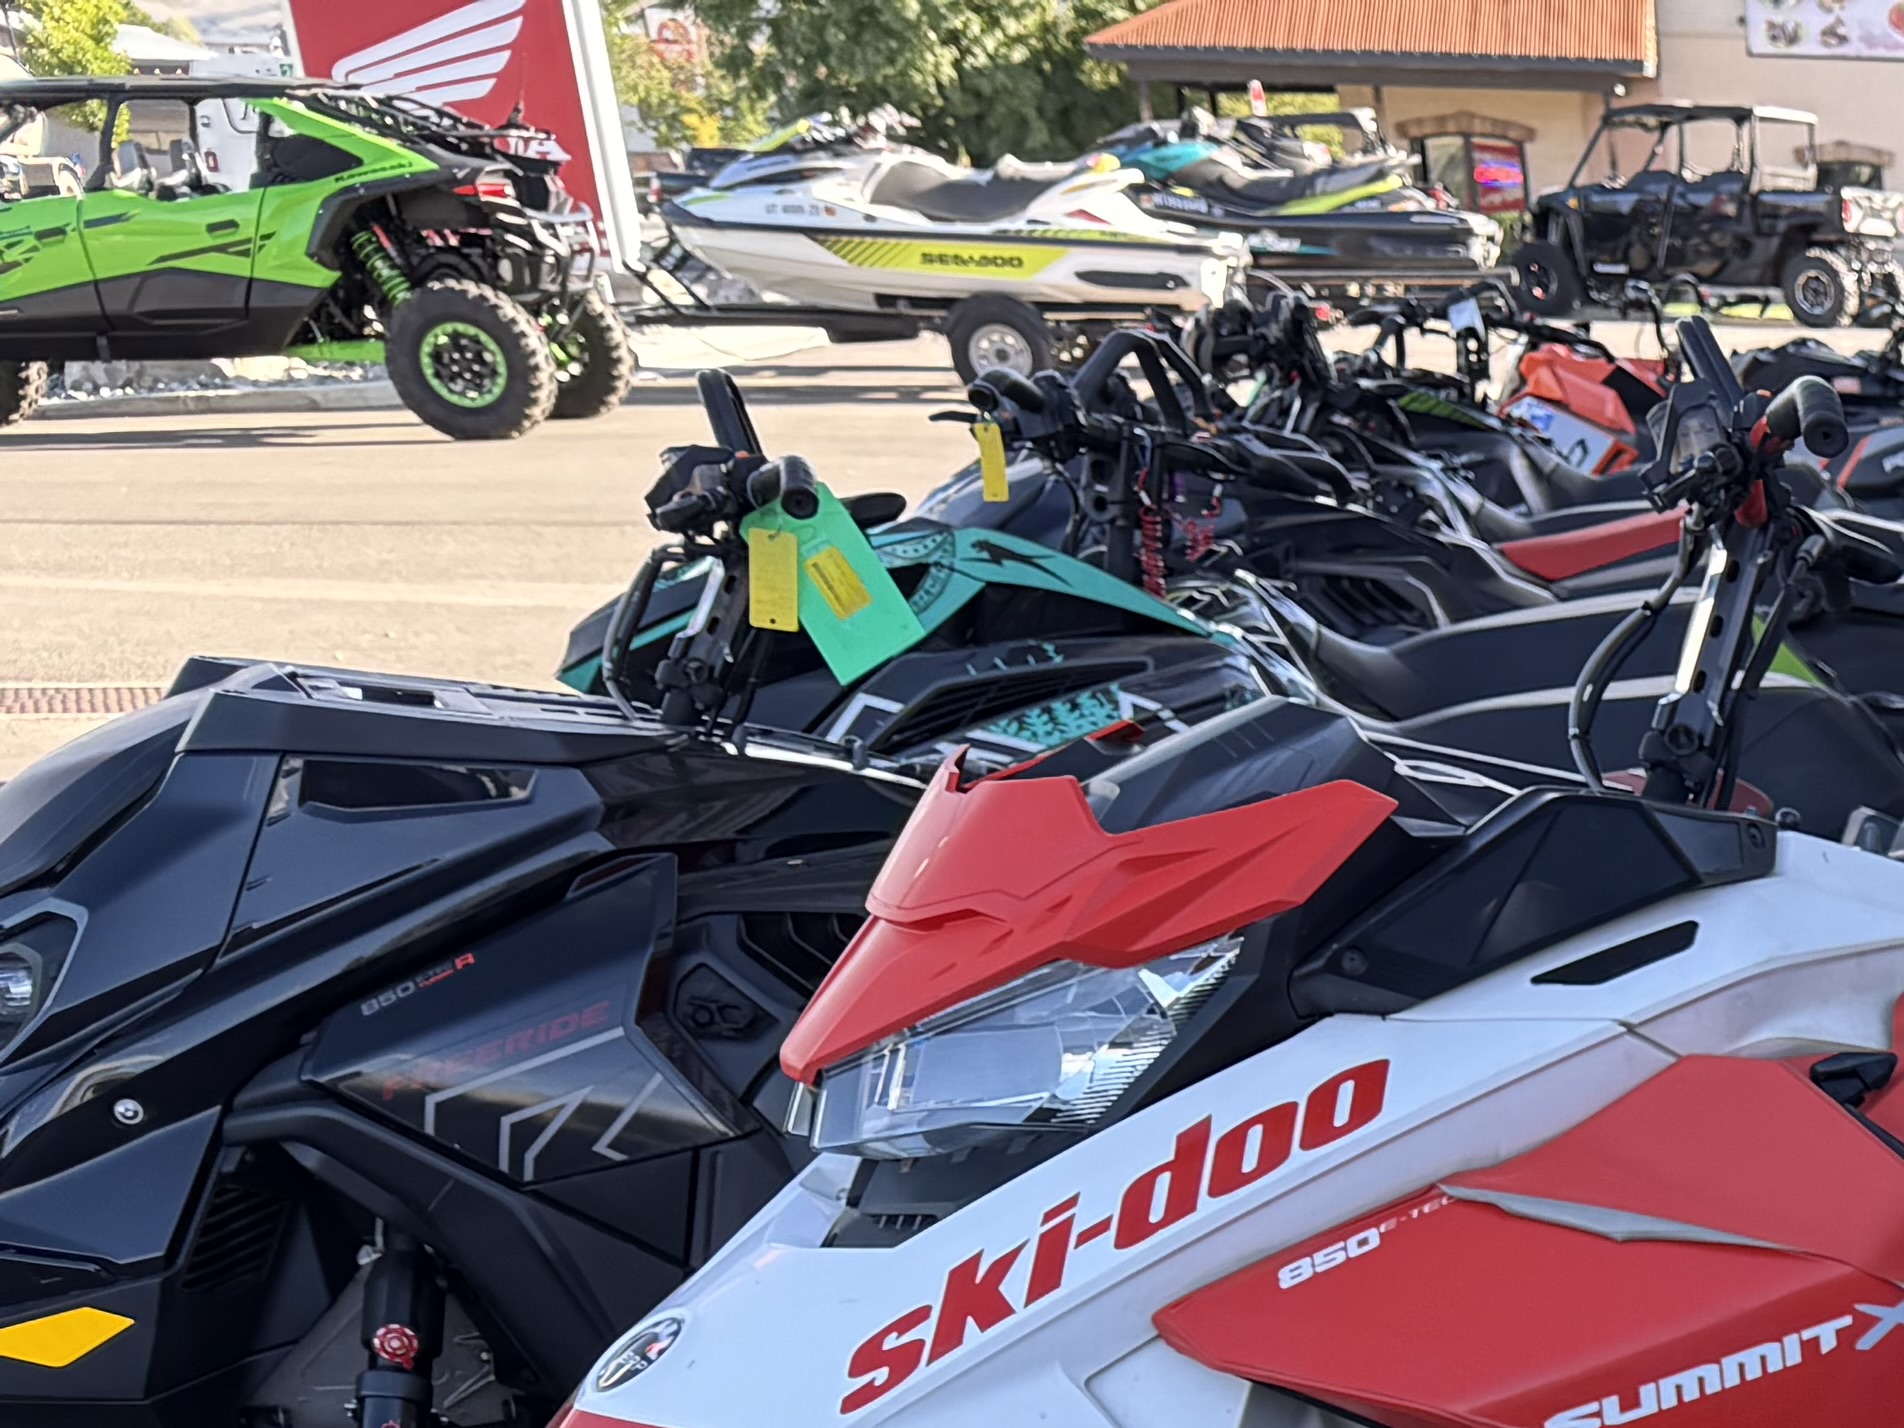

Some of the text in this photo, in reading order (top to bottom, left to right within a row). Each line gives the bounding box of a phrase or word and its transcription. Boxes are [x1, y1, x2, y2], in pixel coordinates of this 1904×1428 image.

[361, 981, 415, 1016] 850
[839, 1058, 1390, 1416] ski-doo
[1277, 1231, 1382, 1290] 850
